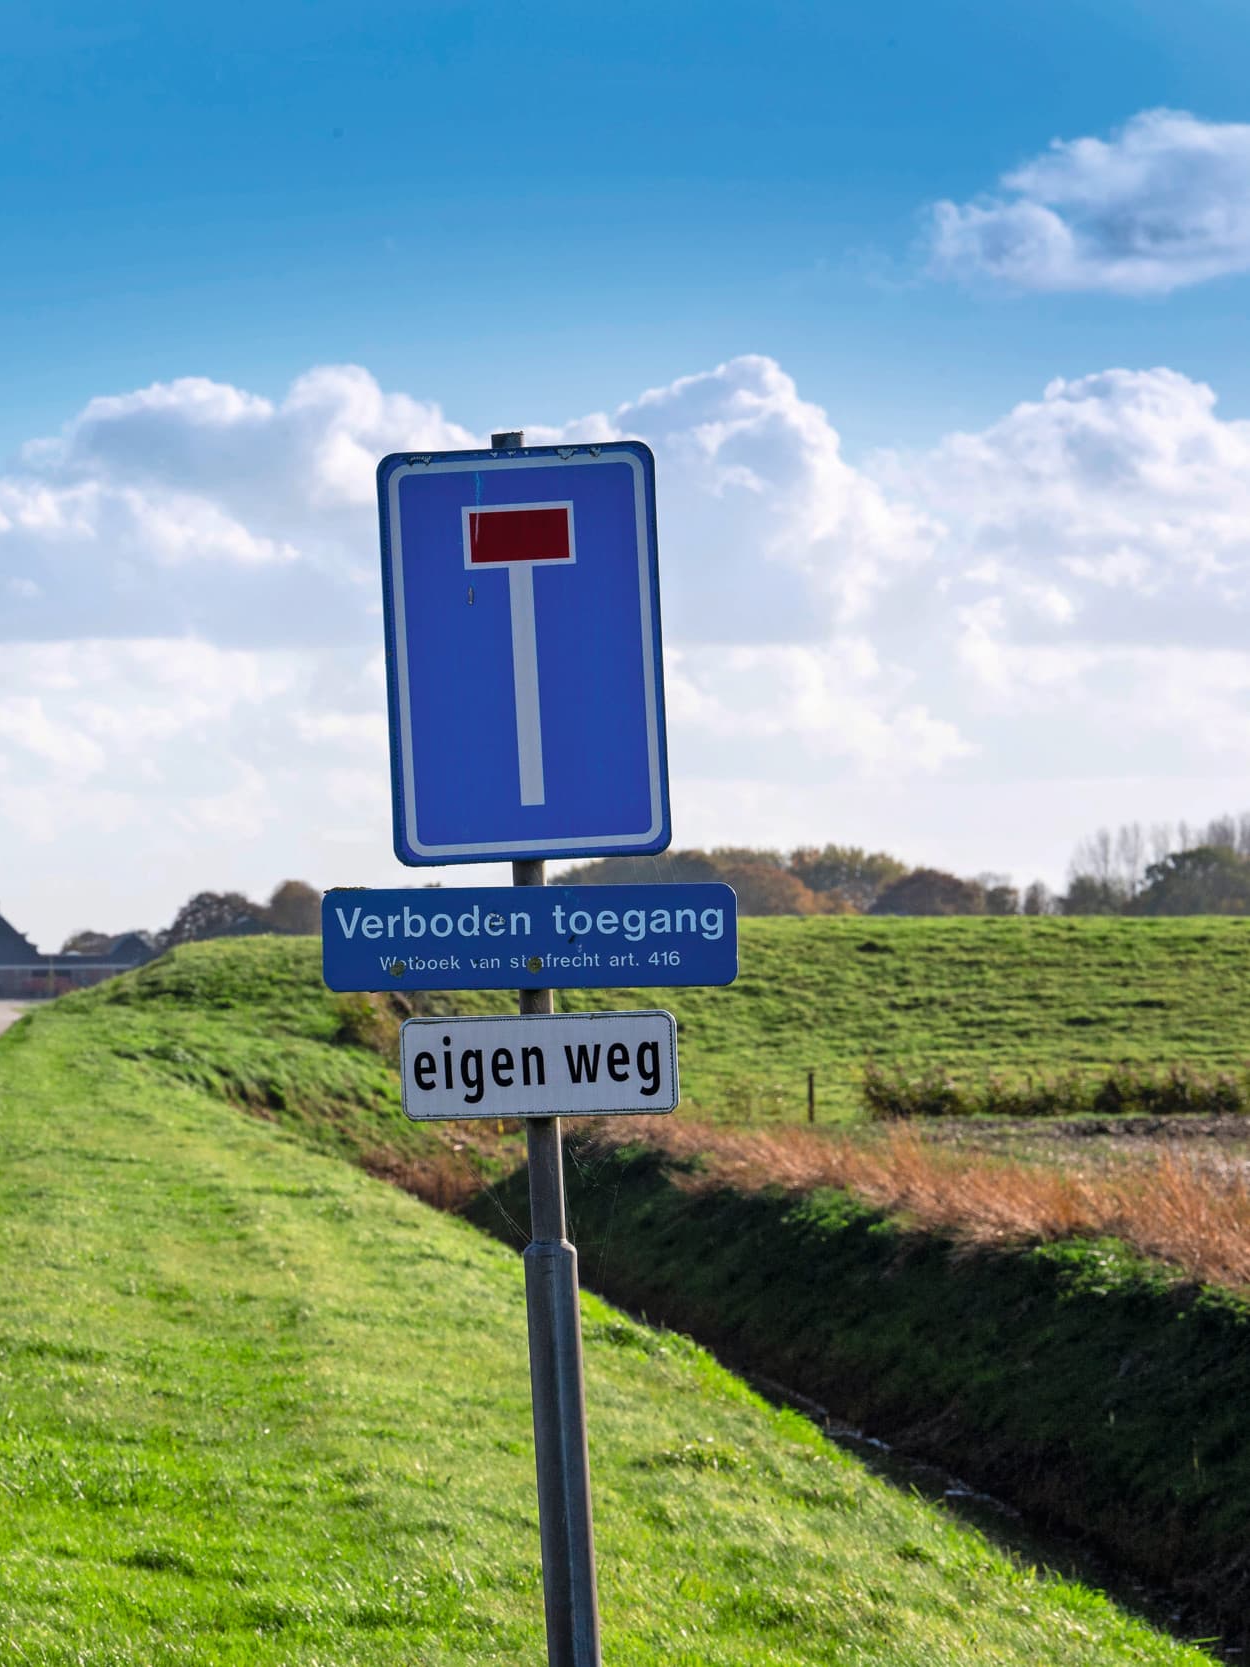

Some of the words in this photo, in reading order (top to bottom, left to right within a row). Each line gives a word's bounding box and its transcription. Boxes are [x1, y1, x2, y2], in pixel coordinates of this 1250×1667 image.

[335, 905, 531, 939] Verboden
[553, 903, 724, 940] toegang
[470, 957, 501, 969] van
[510, 952, 600, 969] stfrecht
[609, 952, 640, 967] art.
[648, 951, 681, 966] 416
[413, 1035, 546, 1104] eigen
[564, 1041, 661, 1096] weg
